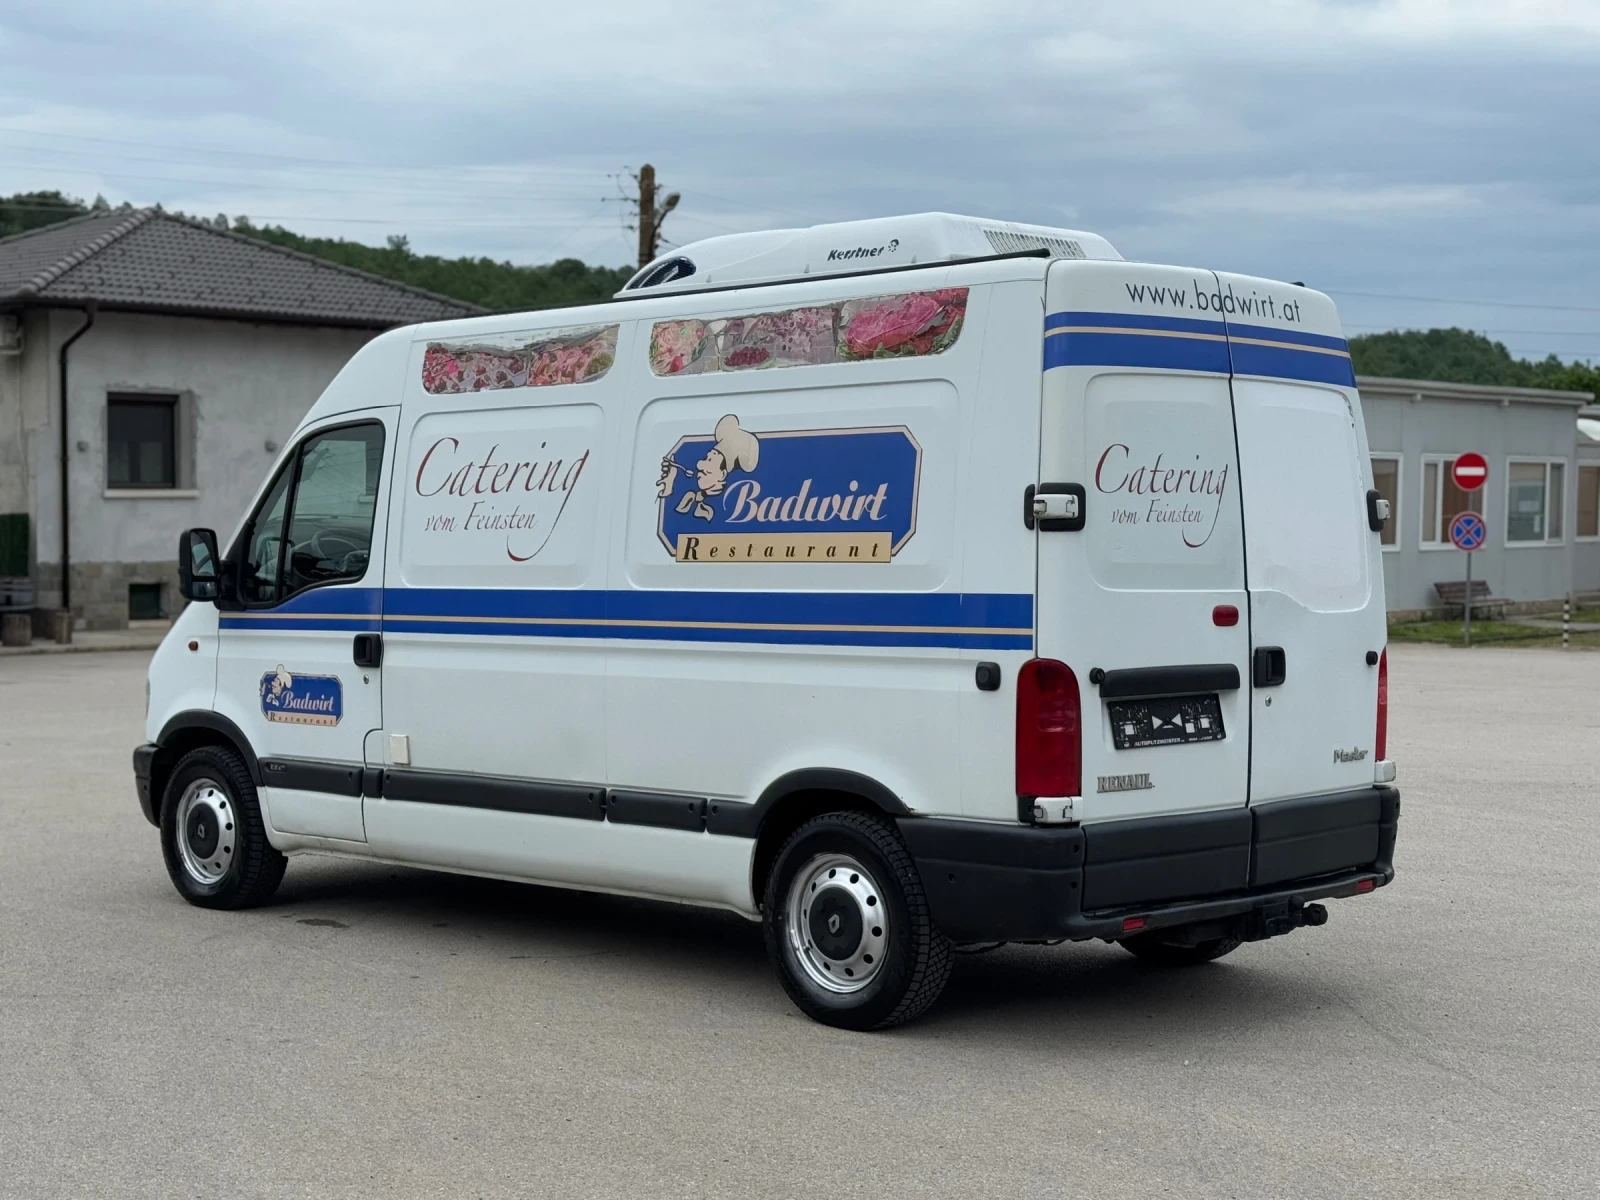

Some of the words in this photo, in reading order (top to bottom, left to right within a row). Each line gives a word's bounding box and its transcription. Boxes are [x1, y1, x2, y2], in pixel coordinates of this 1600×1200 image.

[1125, 279, 1301, 323] www.badwirt.at
[416, 432, 590, 562] Catering
[722, 478, 889, 523] Badwirt
[1095, 443, 1229, 549] Catering
[1111, 508, 1140, 524] vom
[1146, 498, 1204, 524] Feinsten
[424, 513, 458, 532] vom
[463, 500, 538, 531] Feinsten
[682, 536, 879, 561] Restaurant
[281, 690, 335, 712] Badwirt
[270, 711, 334, 725] Restaurant
